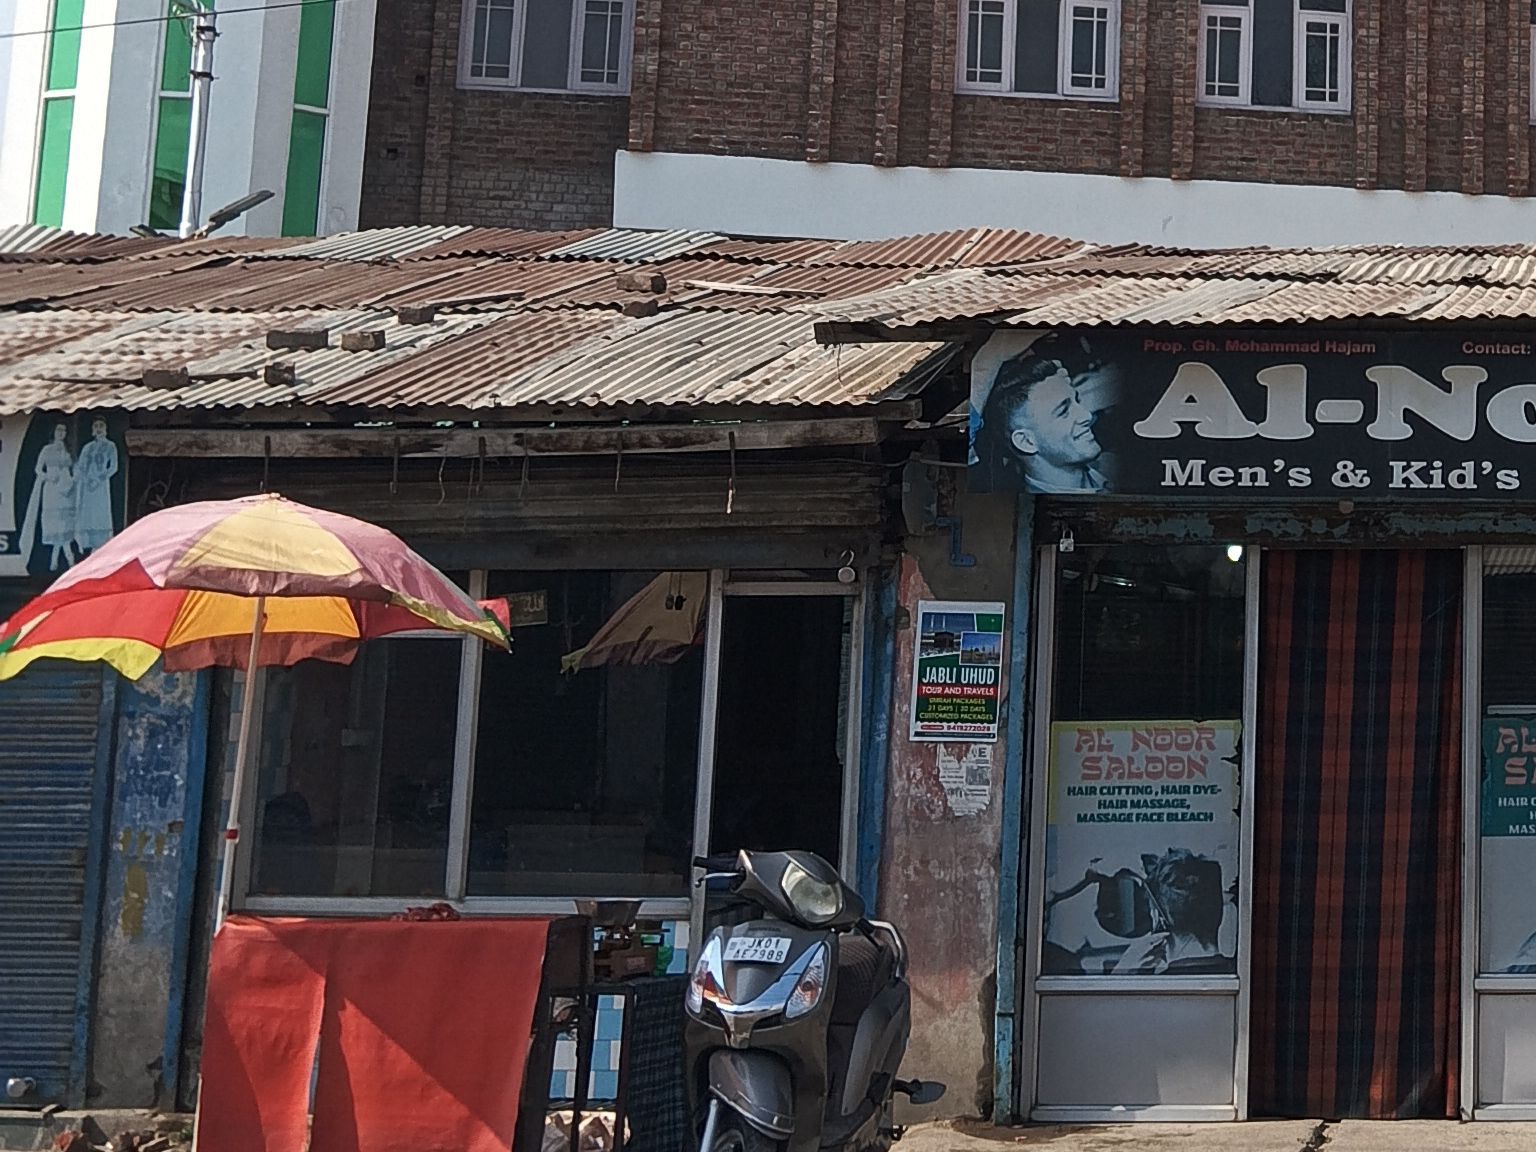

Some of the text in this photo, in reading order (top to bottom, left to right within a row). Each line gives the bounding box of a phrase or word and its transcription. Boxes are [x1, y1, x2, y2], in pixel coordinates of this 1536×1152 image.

[1143, 339, 1376, 355] Prop. Gh. Mohammad Hajam
[1462, 341, 1531, 355] Contact:
[1160, 459, 1313, 487] Men's
[1331, 460, 1371, 488] &
[1388, 460, 1520, 489] Kid's
[921, 666, 995, 685] JABLI UHUD
[921, 686, 994, 696] TOUR AND TRAVELS
[1074, 726, 1216, 753] AL NOOR
[1080, 754, 1209, 781] SALOON
[1067, 785, 1097, 796] HAIR
[1099, 785, 1153, 796] CUTTING
[1160, 785, 1191, 796] HAIR
[1097, 799, 1191, 810] HAIR MASSAGE,
[1498, 796, 1529, 807] HAIR
[1076, 812, 1214, 824] MASSAGE FACE BLEACH
